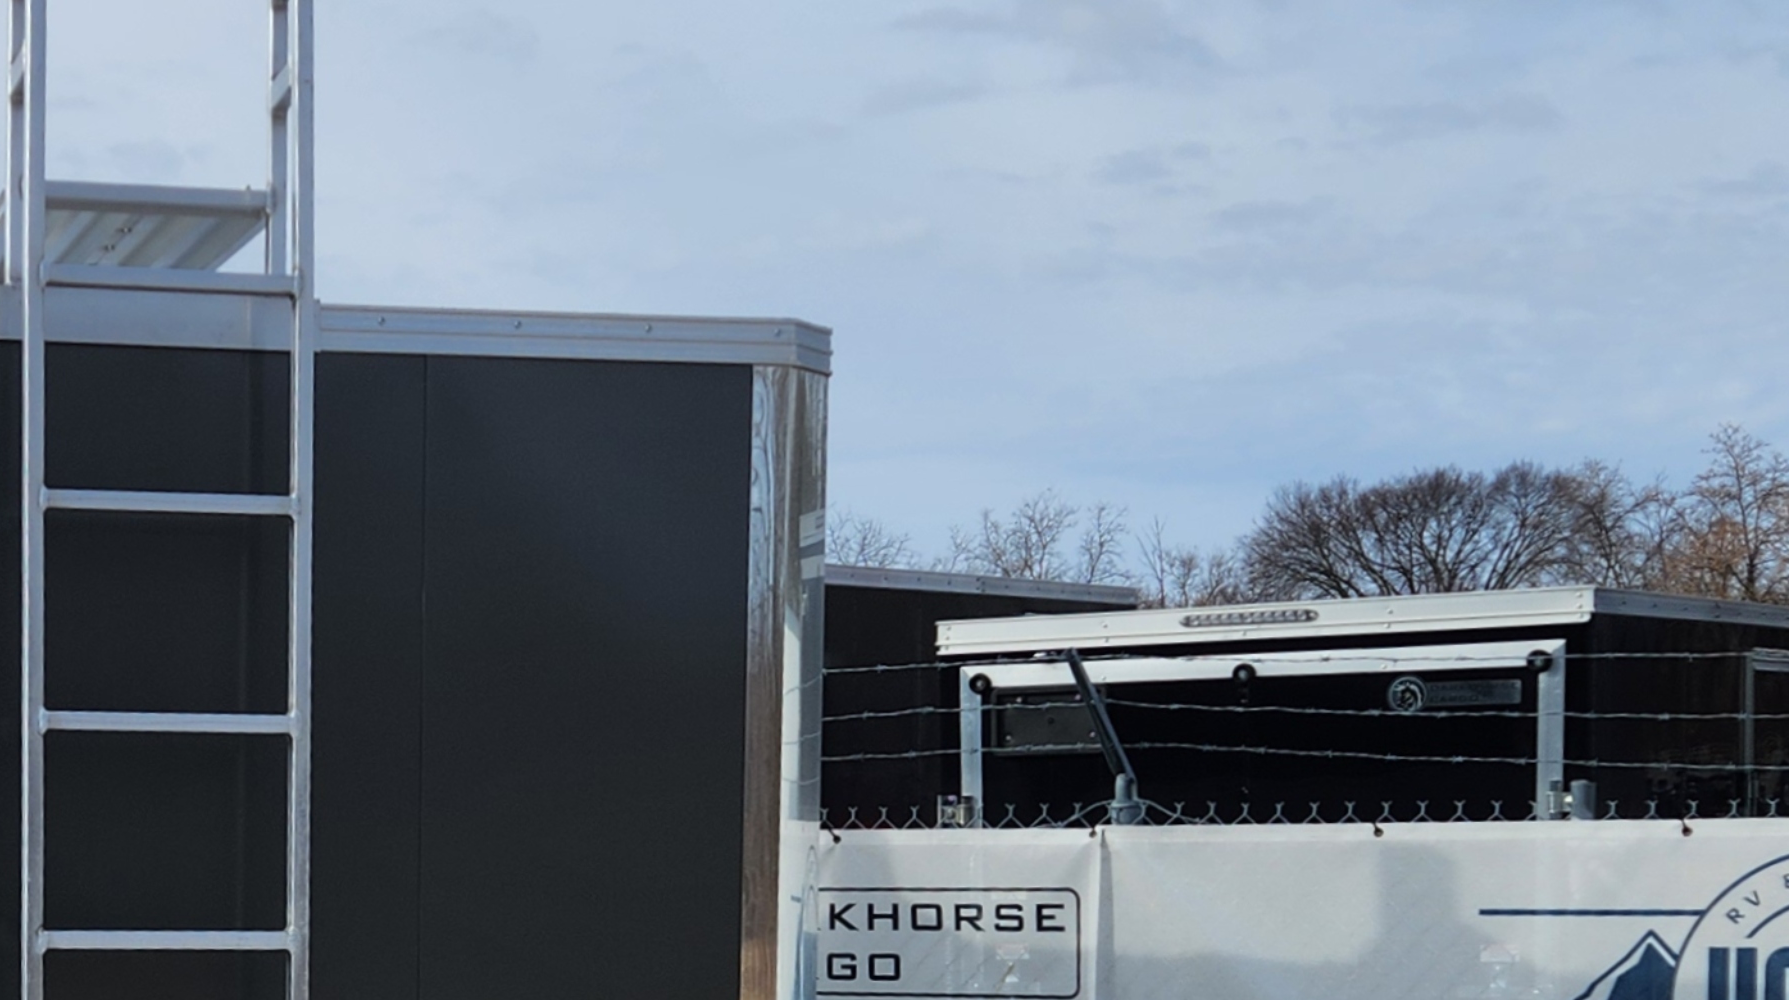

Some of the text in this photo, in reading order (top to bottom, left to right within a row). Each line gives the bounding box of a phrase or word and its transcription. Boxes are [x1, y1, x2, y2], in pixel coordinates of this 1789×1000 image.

[826, 902, 1066, 933] KHORSE
[1724, 889, 1762, 925] RV
[825, 952, 902, 982] GO
